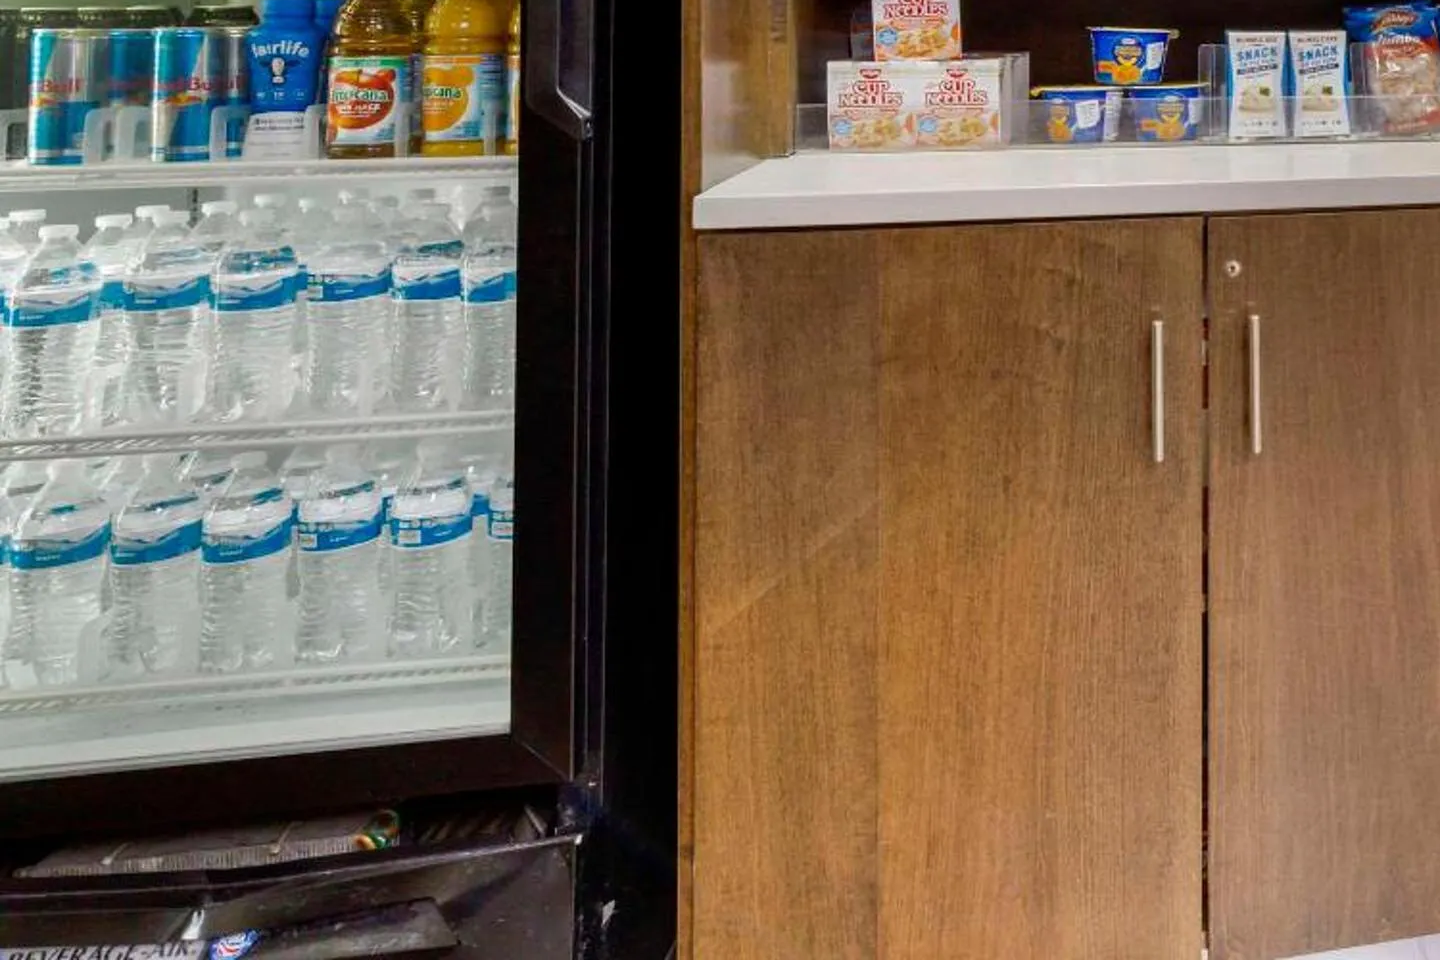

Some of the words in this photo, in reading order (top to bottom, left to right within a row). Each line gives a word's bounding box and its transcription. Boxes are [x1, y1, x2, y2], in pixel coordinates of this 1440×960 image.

[883, 3, 948, 19] NOODLES
[252, 40, 311, 59] fairlife
[1237, 46, 1278, 62] SNACK
[1298, 45, 1339, 62] SNACK
[853, 80, 890, 94] CUP
[939, 80, 975, 95] CUP
[838, 93, 903, 108] NOODLES
[925, 92, 988, 106] NOODLES
